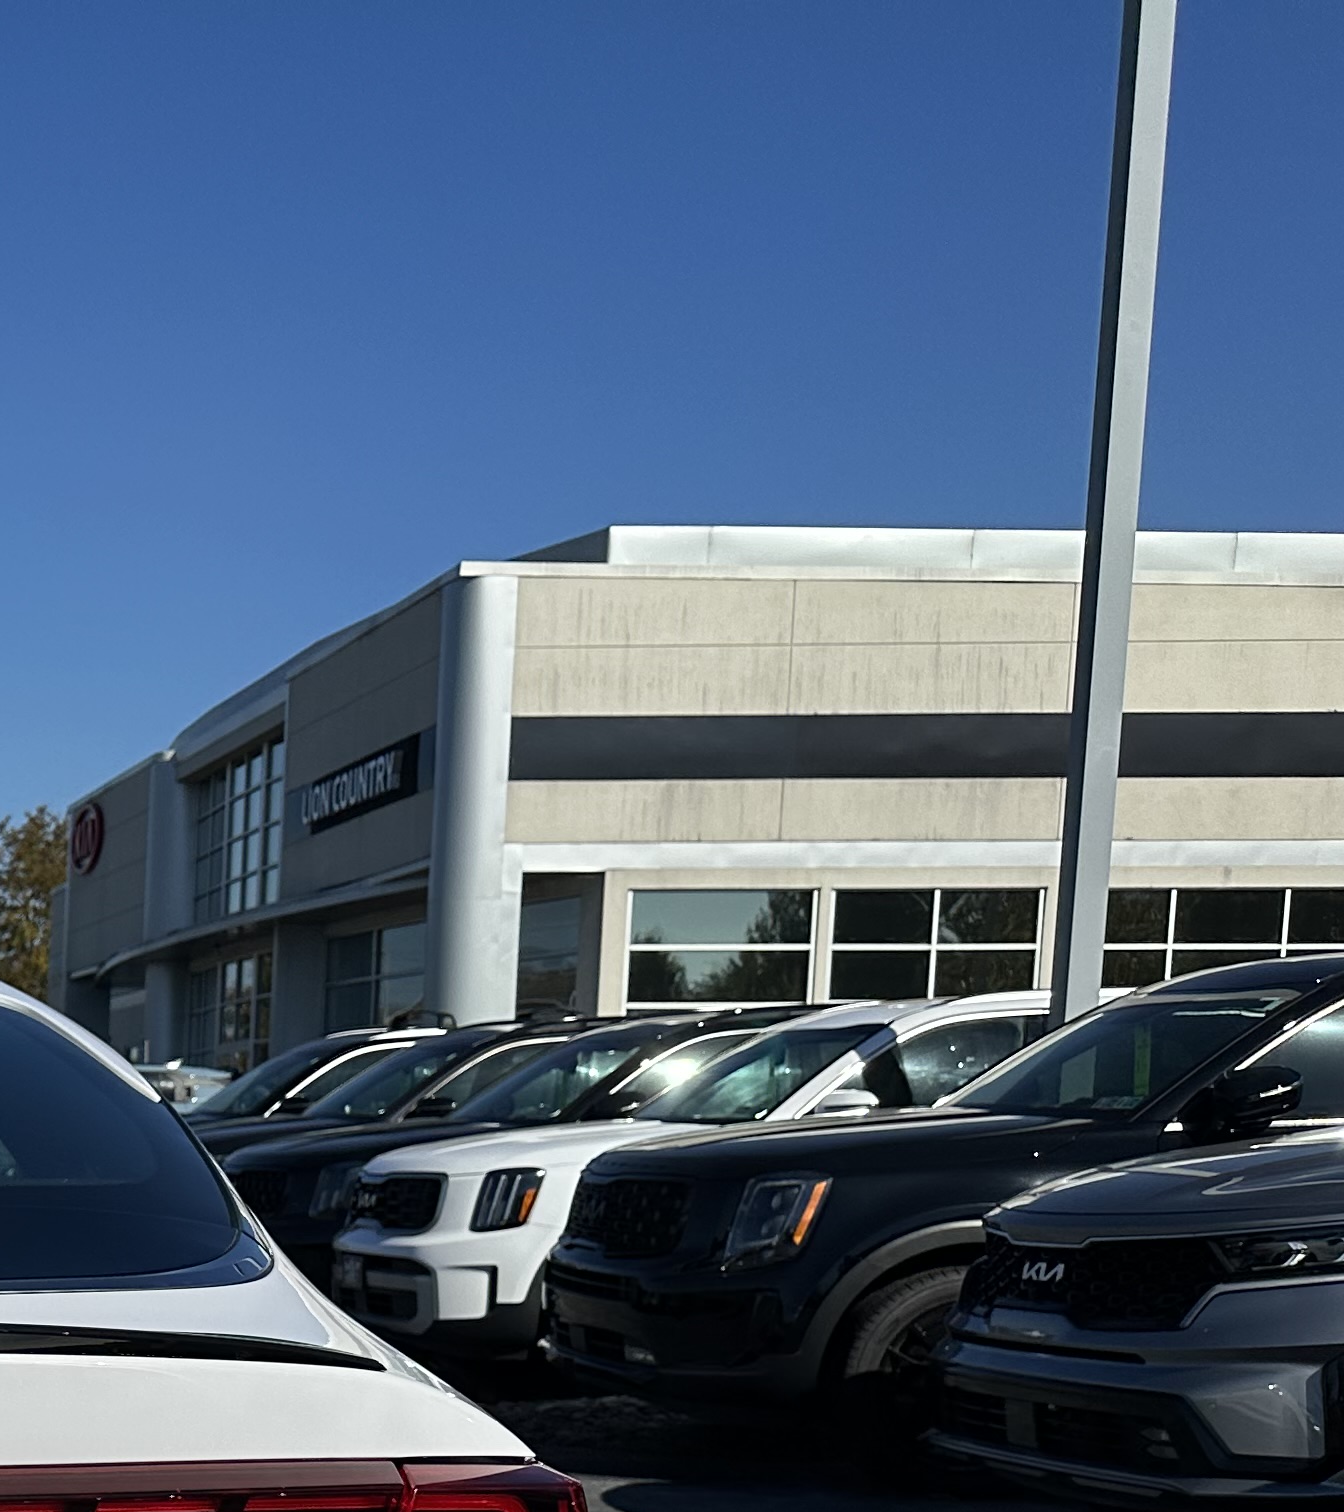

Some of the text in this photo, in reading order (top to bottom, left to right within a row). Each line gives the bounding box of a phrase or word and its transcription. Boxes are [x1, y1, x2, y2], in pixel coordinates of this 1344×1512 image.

[301, 750, 396, 824] LION COUNTRY
[1022, 1261, 1065, 1282] KIA
